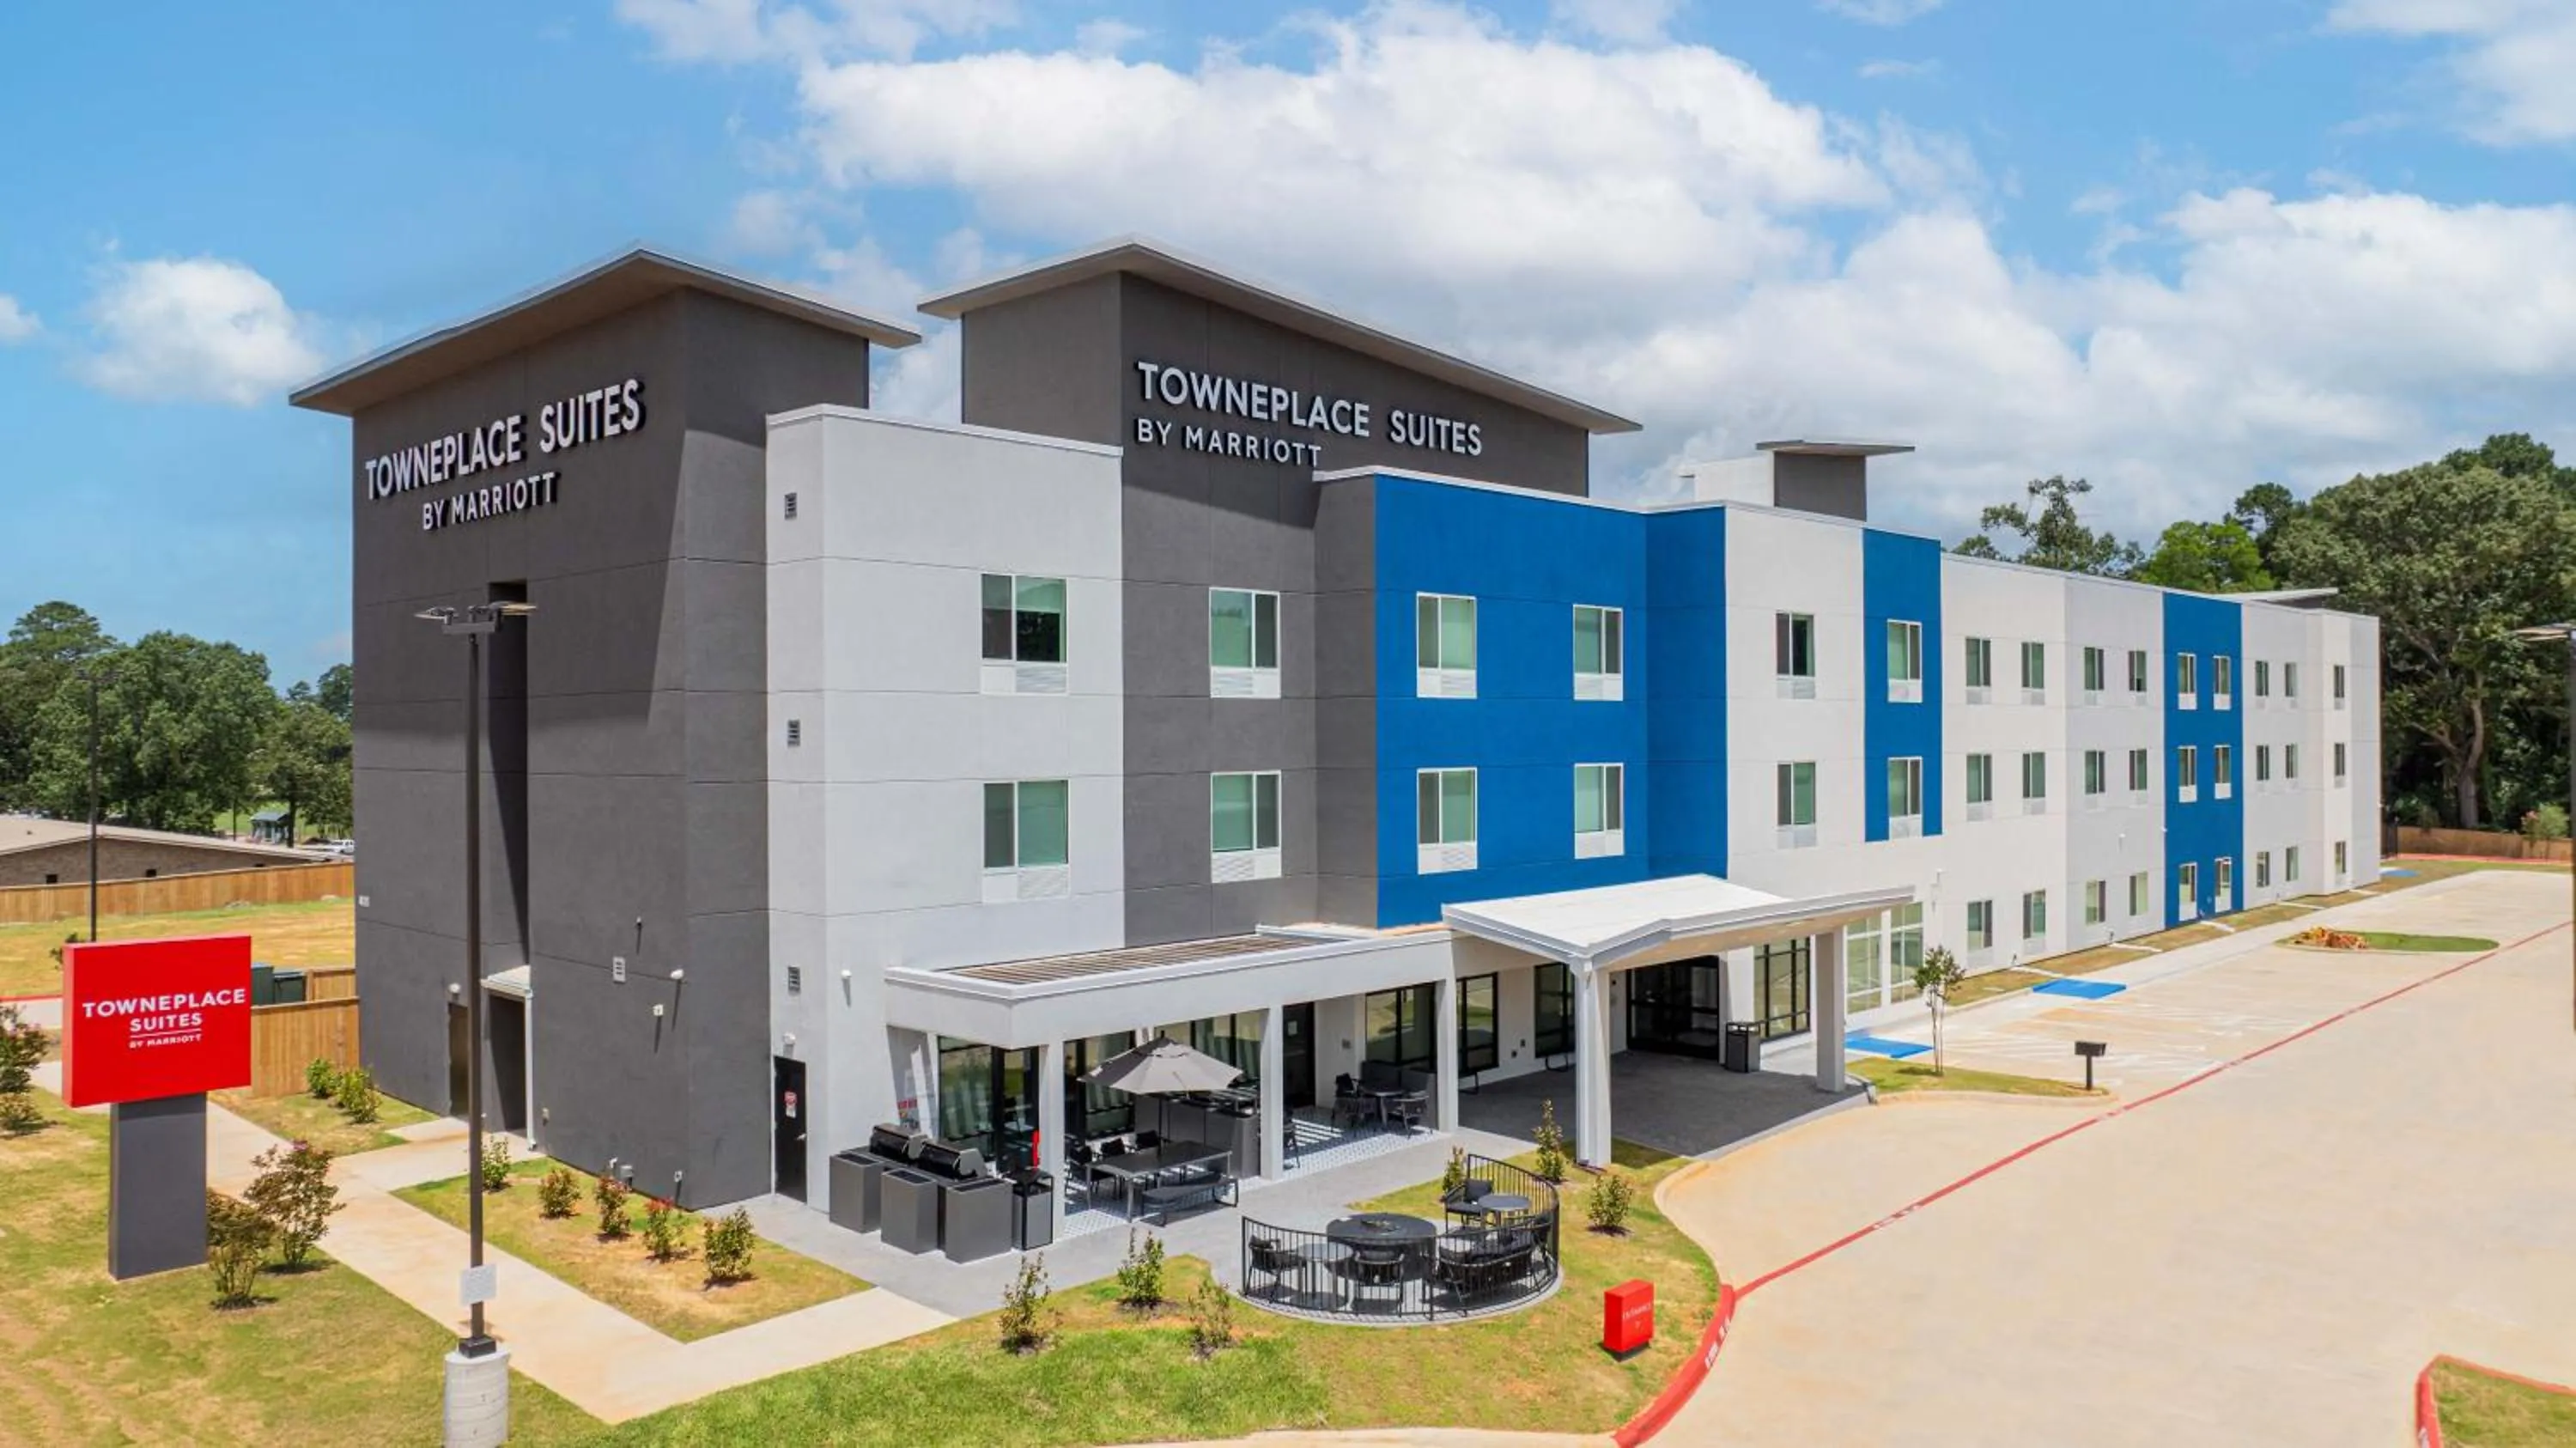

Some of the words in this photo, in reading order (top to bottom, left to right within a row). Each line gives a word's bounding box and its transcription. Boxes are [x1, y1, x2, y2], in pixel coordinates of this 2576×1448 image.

[1138, 361, 1370, 437] TOWNEPLACE
[1390, 410, 1483, 457] SUITES
[365, 414, 521, 501] TOWNEPLACE
[538, 378, 641, 453] SUITES
[1138, 418, 1172, 446] BY
[1186, 426, 1322, 467] MARRIOTT
[422, 501, 445, 531] BY
[452, 472, 556, 526] MARRIOTT
[82, 989, 246, 1018] TOWNEPLACE
[130, 1013, 203, 1032] SUITES
